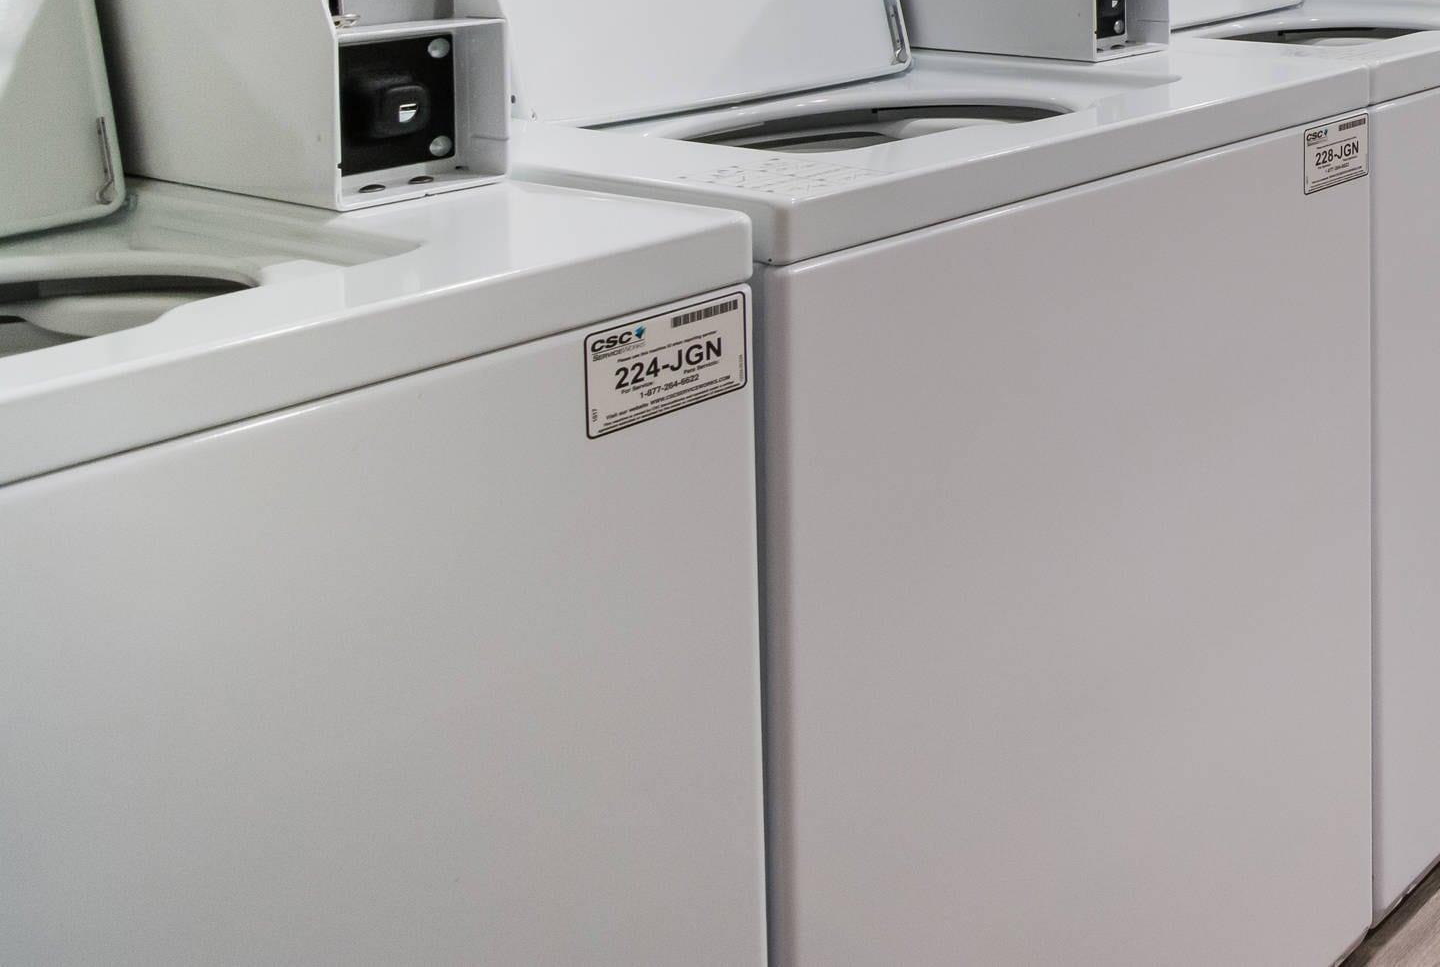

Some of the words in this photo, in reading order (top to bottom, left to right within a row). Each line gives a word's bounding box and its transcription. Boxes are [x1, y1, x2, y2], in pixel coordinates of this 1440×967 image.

[1307, 130, 1323, 141] CSC
[1315, 140, 1359, 166] 228-JGN
[591, 332, 632, 352] CSC
[615, 338, 722, 390] 224-JGN
